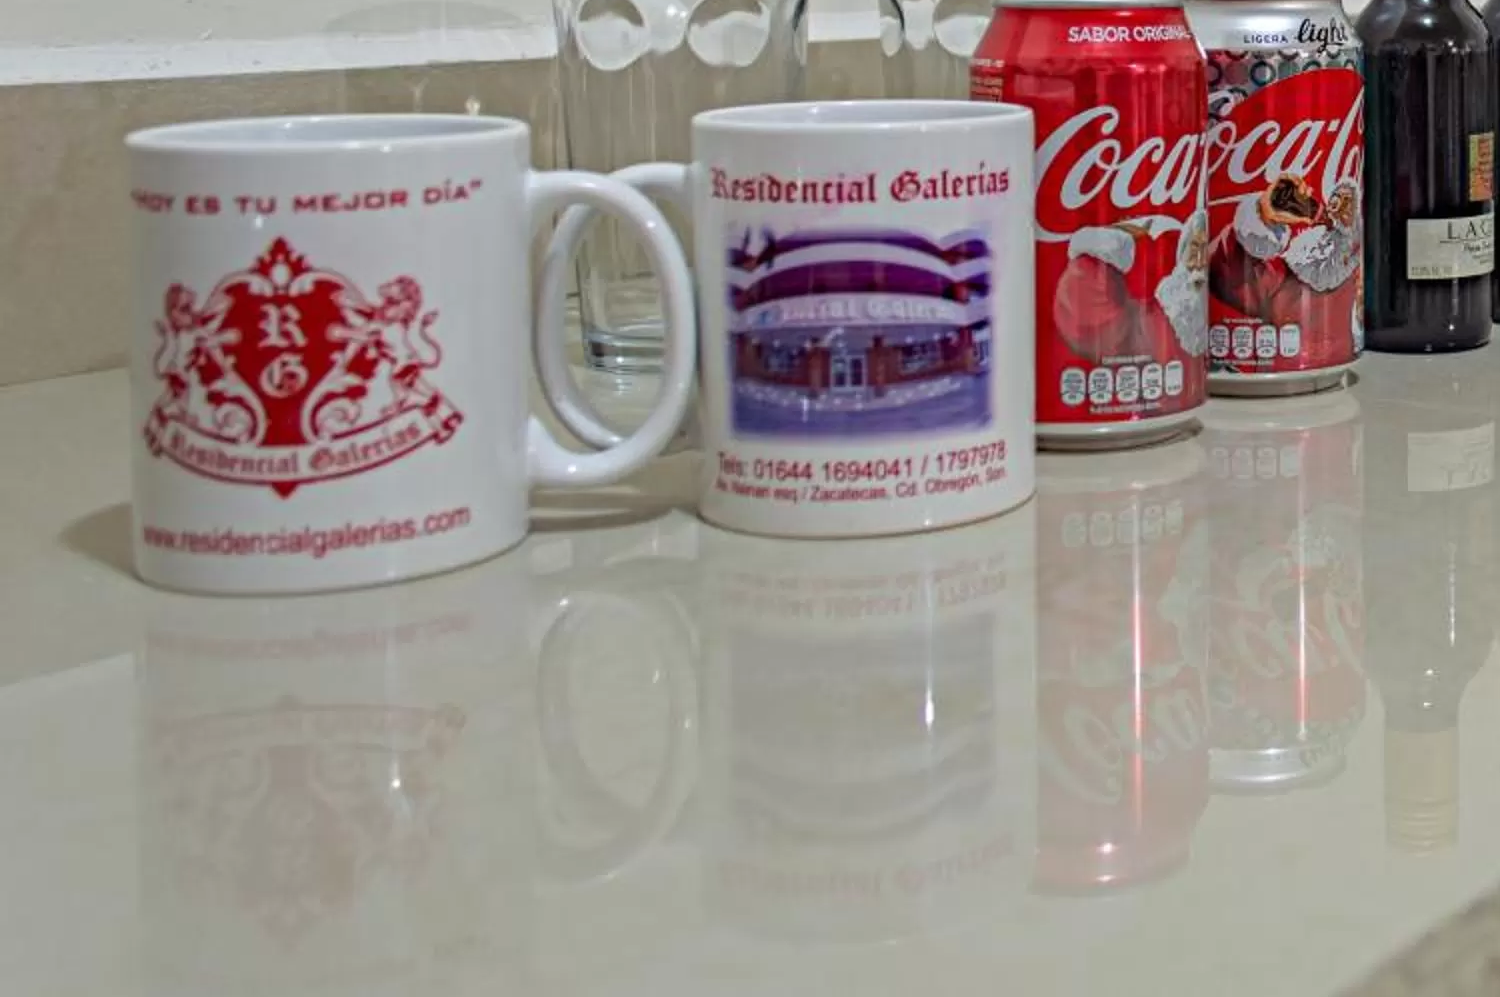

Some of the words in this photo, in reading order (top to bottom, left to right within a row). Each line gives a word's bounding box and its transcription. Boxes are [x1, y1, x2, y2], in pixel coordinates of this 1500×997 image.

[1068, 25, 1131, 43] SABOR
[184, 195, 221, 215] ES
[234, 195, 277, 215] TU
[292, 189, 409, 214] MEJOR
[711, 166, 878, 205] Residencial
[889, 160, 1011, 203] Galerías
[257, 303, 309, 348] R
[753, 458, 812, 481] 01644
[822, 456, 913, 482] 1694041
[936, 439, 1006, 475] 1797978
